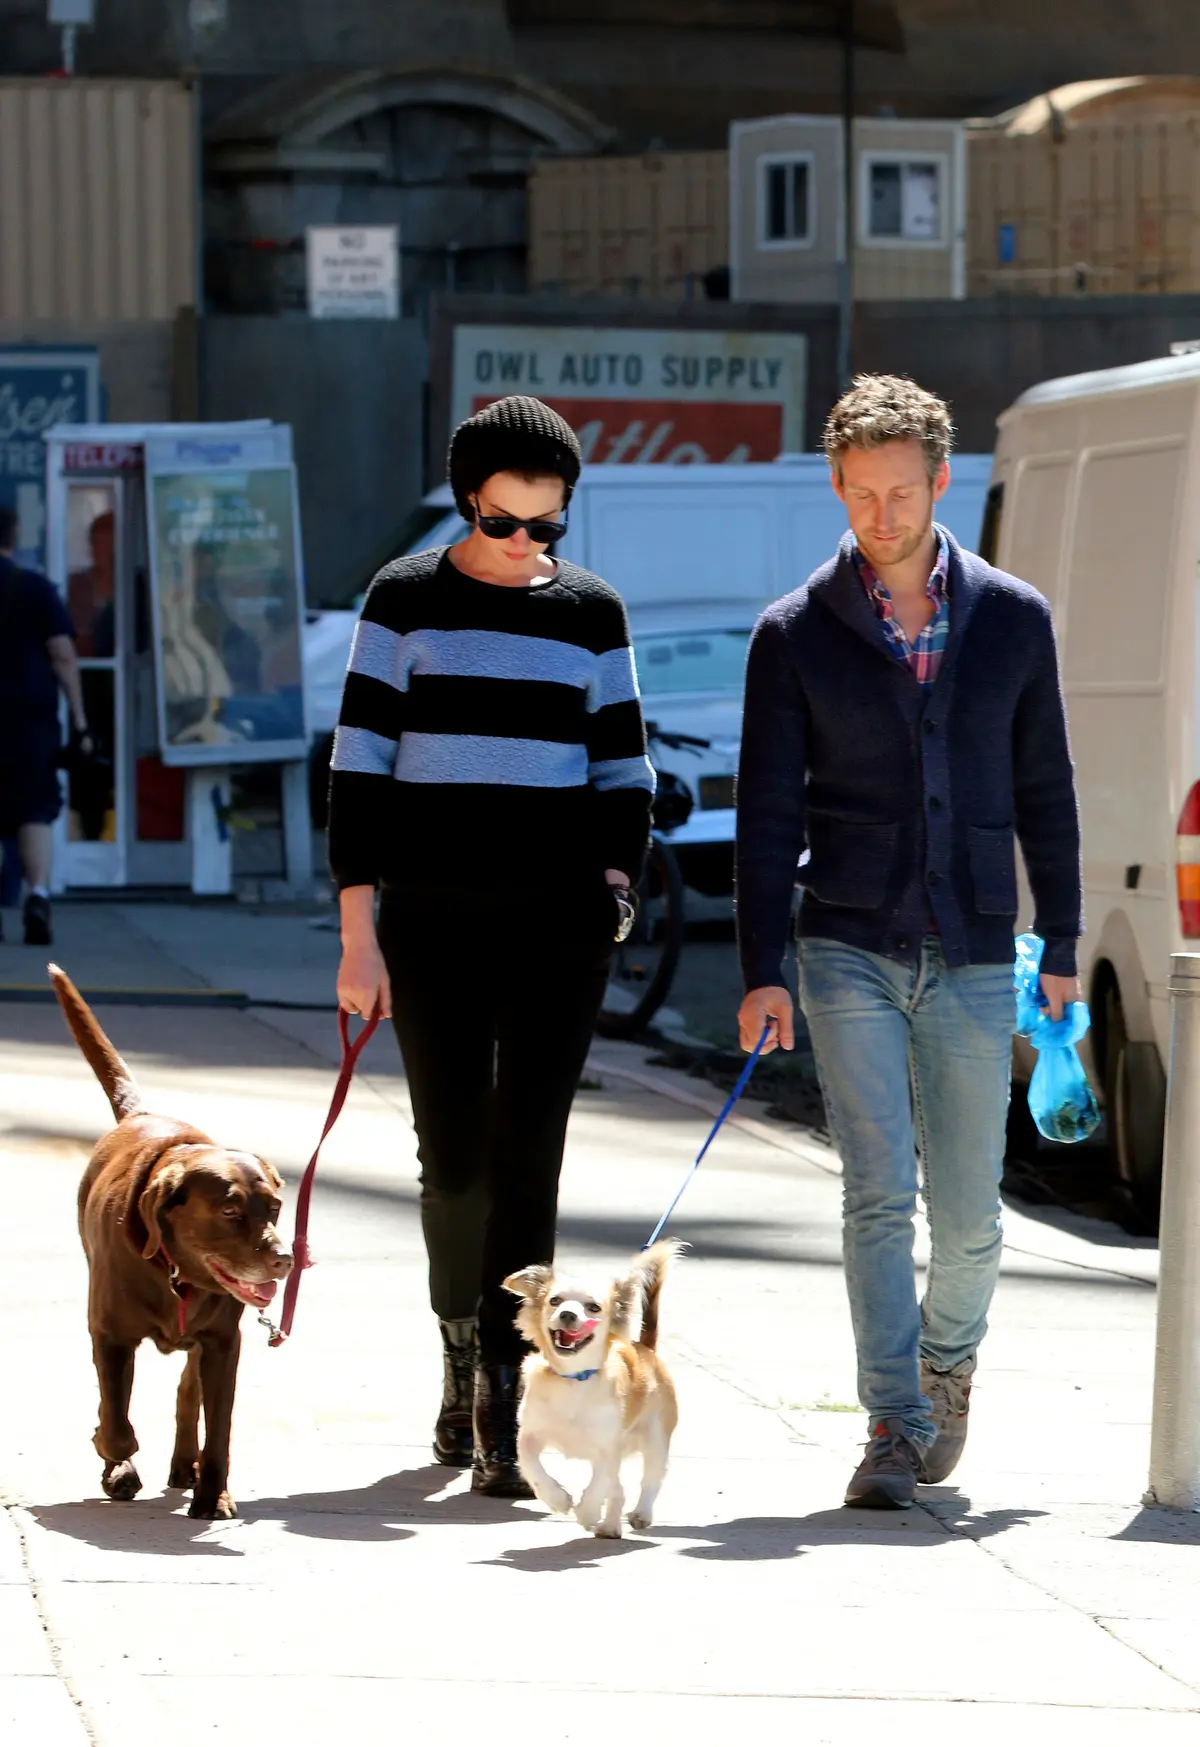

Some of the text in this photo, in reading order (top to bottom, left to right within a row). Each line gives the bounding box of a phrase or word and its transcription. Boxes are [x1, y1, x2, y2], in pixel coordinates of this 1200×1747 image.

[475, 351, 784, 389] OWL AUTO SUPPLY
